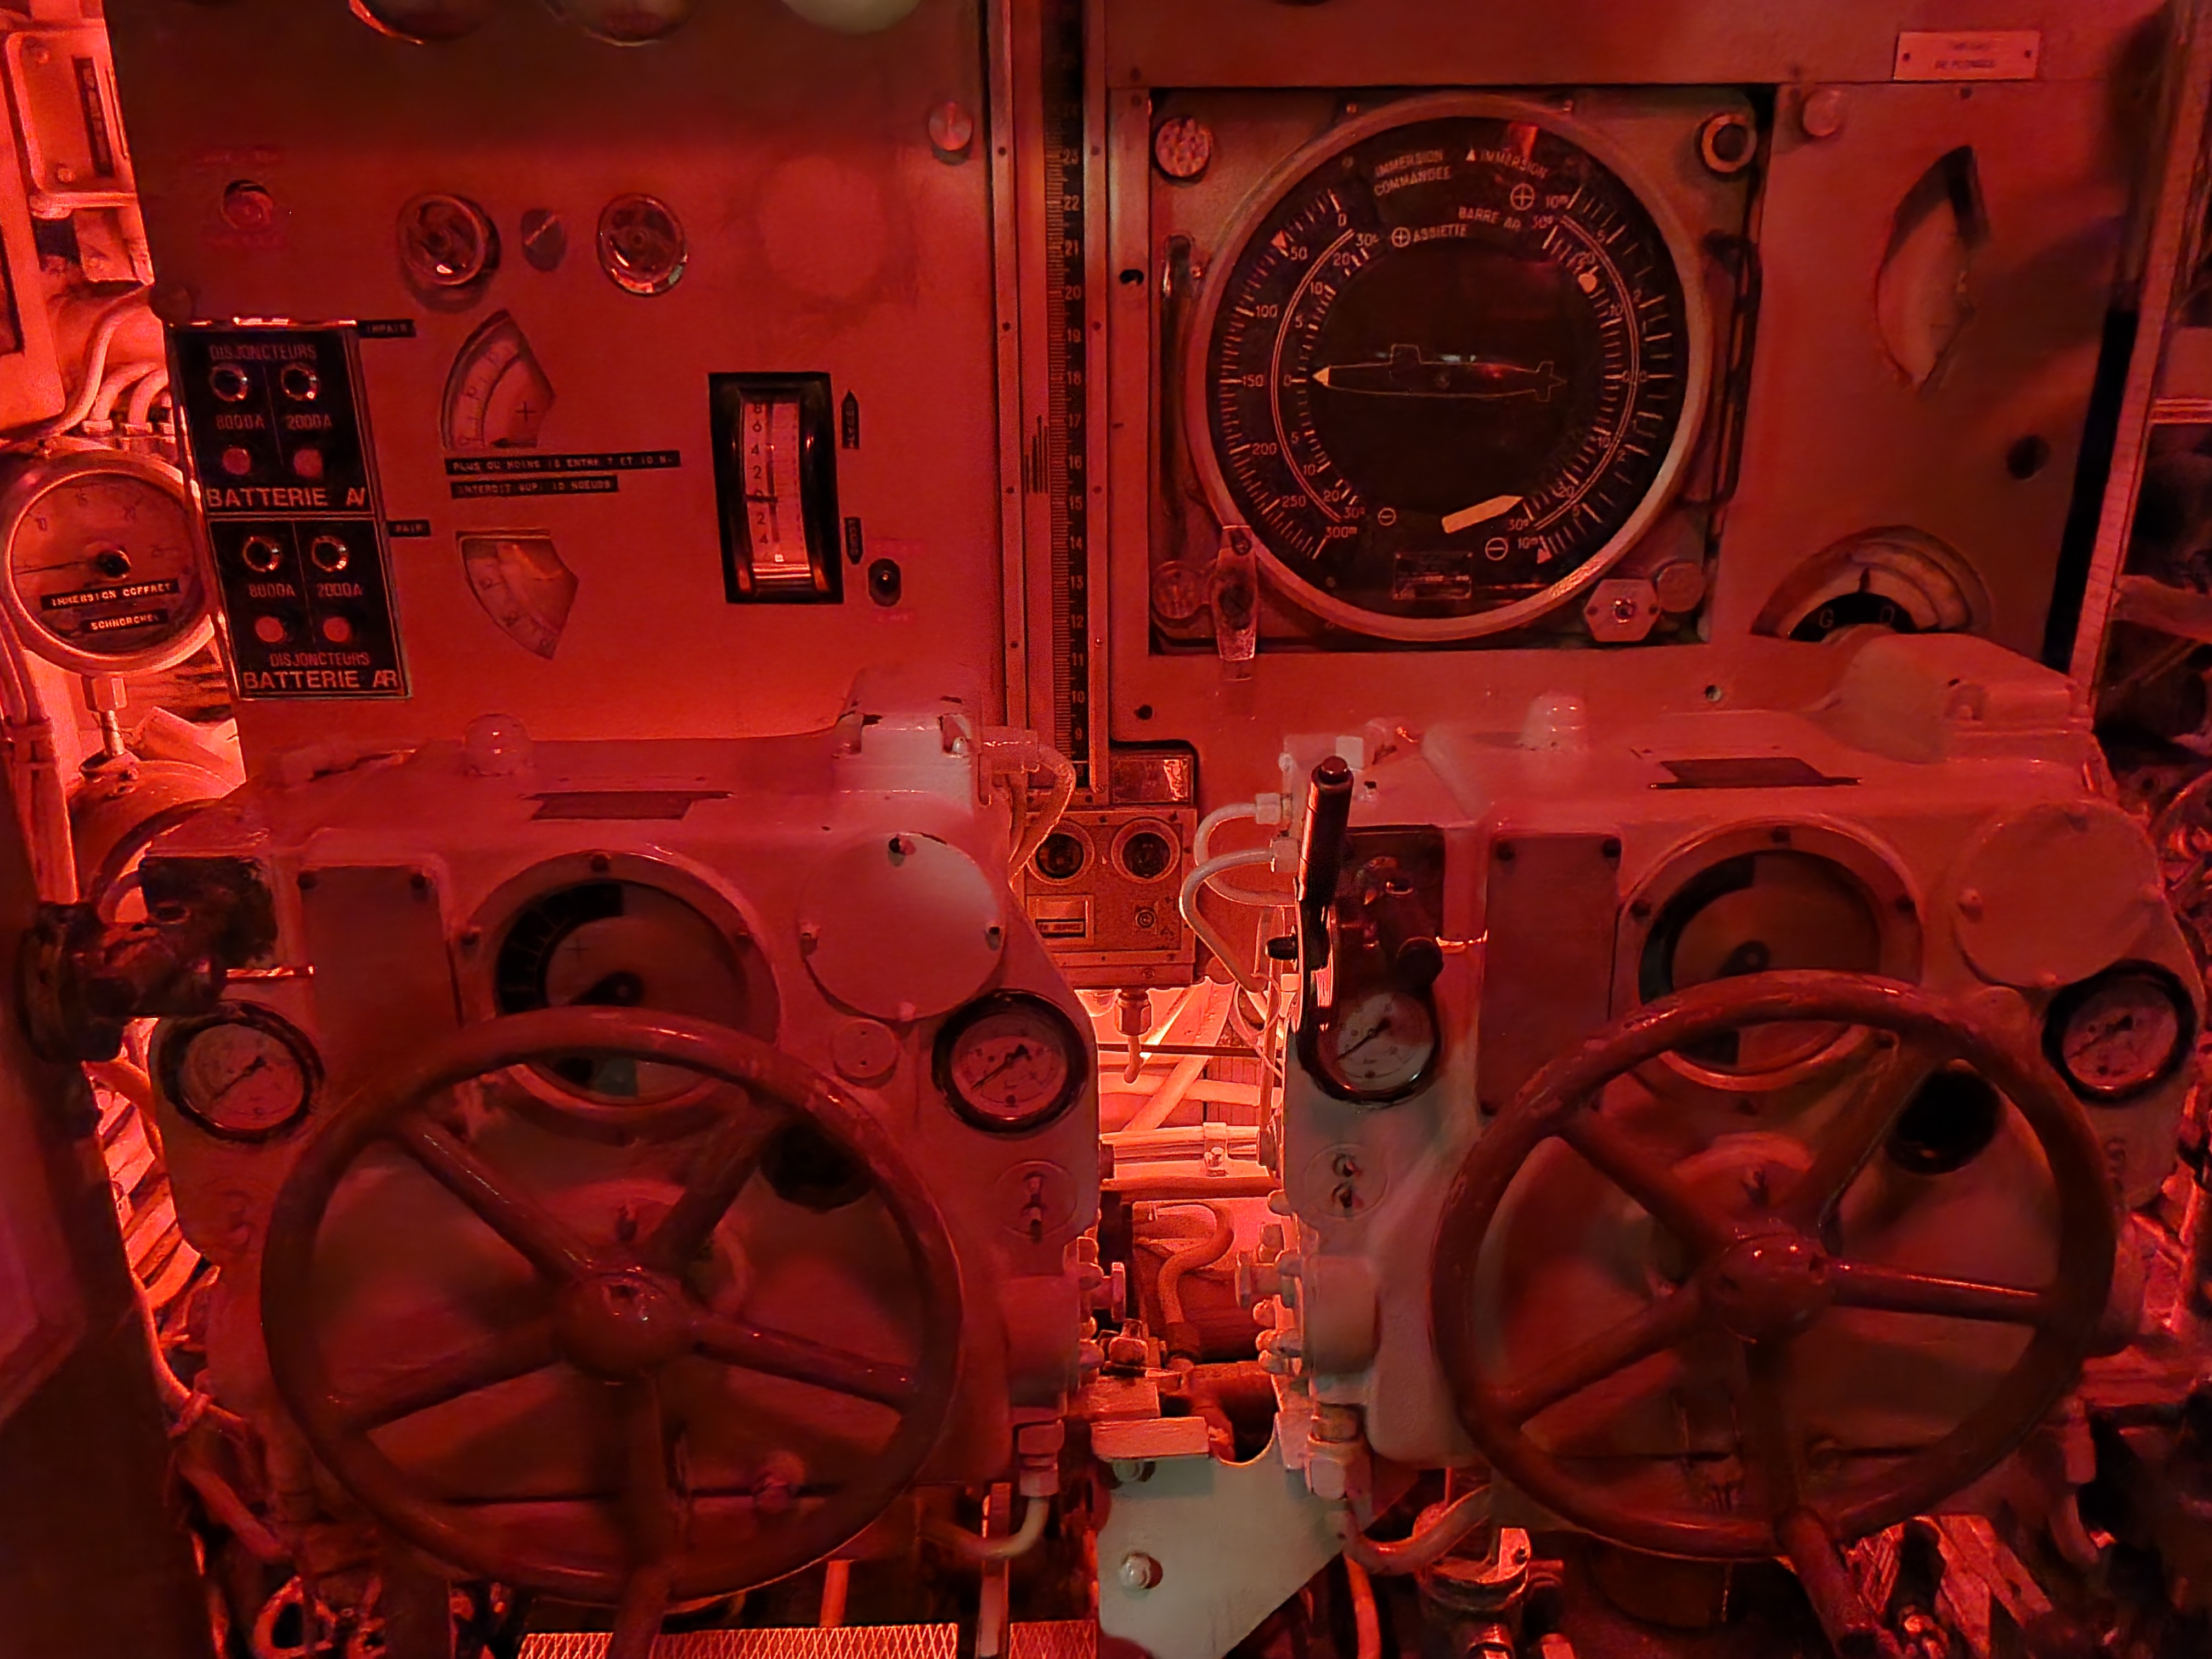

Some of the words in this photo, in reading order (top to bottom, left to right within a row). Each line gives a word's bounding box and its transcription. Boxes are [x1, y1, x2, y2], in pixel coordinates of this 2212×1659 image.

[1374, 150, 1443, 178] IMMERSION
[1064, 196, 1080, 210] 22
[1459, 206, 1500, 224] BARRE
[1413, 224, 1468, 241] ASSIETTE
[1065, 240, 1079, 256] 21
[1290, 247, 1308, 260] 50
[1333, 252, 1350, 267] 20
[1065, 285, 1081, 300] 20
[1311, 281, 1323, 295] 10
[1256, 304, 1278, 318] 100
[1295, 314, 1303, 328] 5
[1067, 330, 1081, 342] 19
[210, 345, 317, 360] DISJONCTEURS
[1068, 371, 1081, 384] 18
[1243, 375, 1264, 387] 150
[1284, 375, 1291, 387] 0
[216, 414, 265, 429] 8000A
[286, 414, 332, 429] 2000A
[752, 421, 762, 432] 6
[1068, 415, 1081, 427] 17
[1291, 432, 1299, 444] 5
[751, 443, 760, 455] 4
[1252, 443, 1277, 455] 200
[1069, 456, 1081, 469] 16
[752, 465, 762, 479] 2
[1304, 464, 1316, 476] 10
[206, 487, 328, 507] BATTERIE
[1282, 495, 1306, 507] 250
[1323, 490, 1340, 502] 20
[1070, 496, 1082, 510] 15
[757, 512, 766, 525] 2
[759, 533, 768, 544] 4
[1070, 536, 1083, 549] 14
[1070, 576, 1084, 589] 13
[51, 590, 116, 606] IMMERSION
[123, 583, 171, 597] COFFRET
[249, 583, 296, 597] 8000A
[317, 583, 363, 597] 2000A
[1071, 615, 1084, 628] 12
[1819, 608, 1834, 629] G
[269, 652, 370, 667] DISJONCTEURS
[1072, 653, 1084, 666] 11
[243, 670, 360, 689] BATTERIE
[373, 670, 398, 687] AR
[1072, 691, 1085, 703] 10
[1075, 728, 1082, 740] 9
